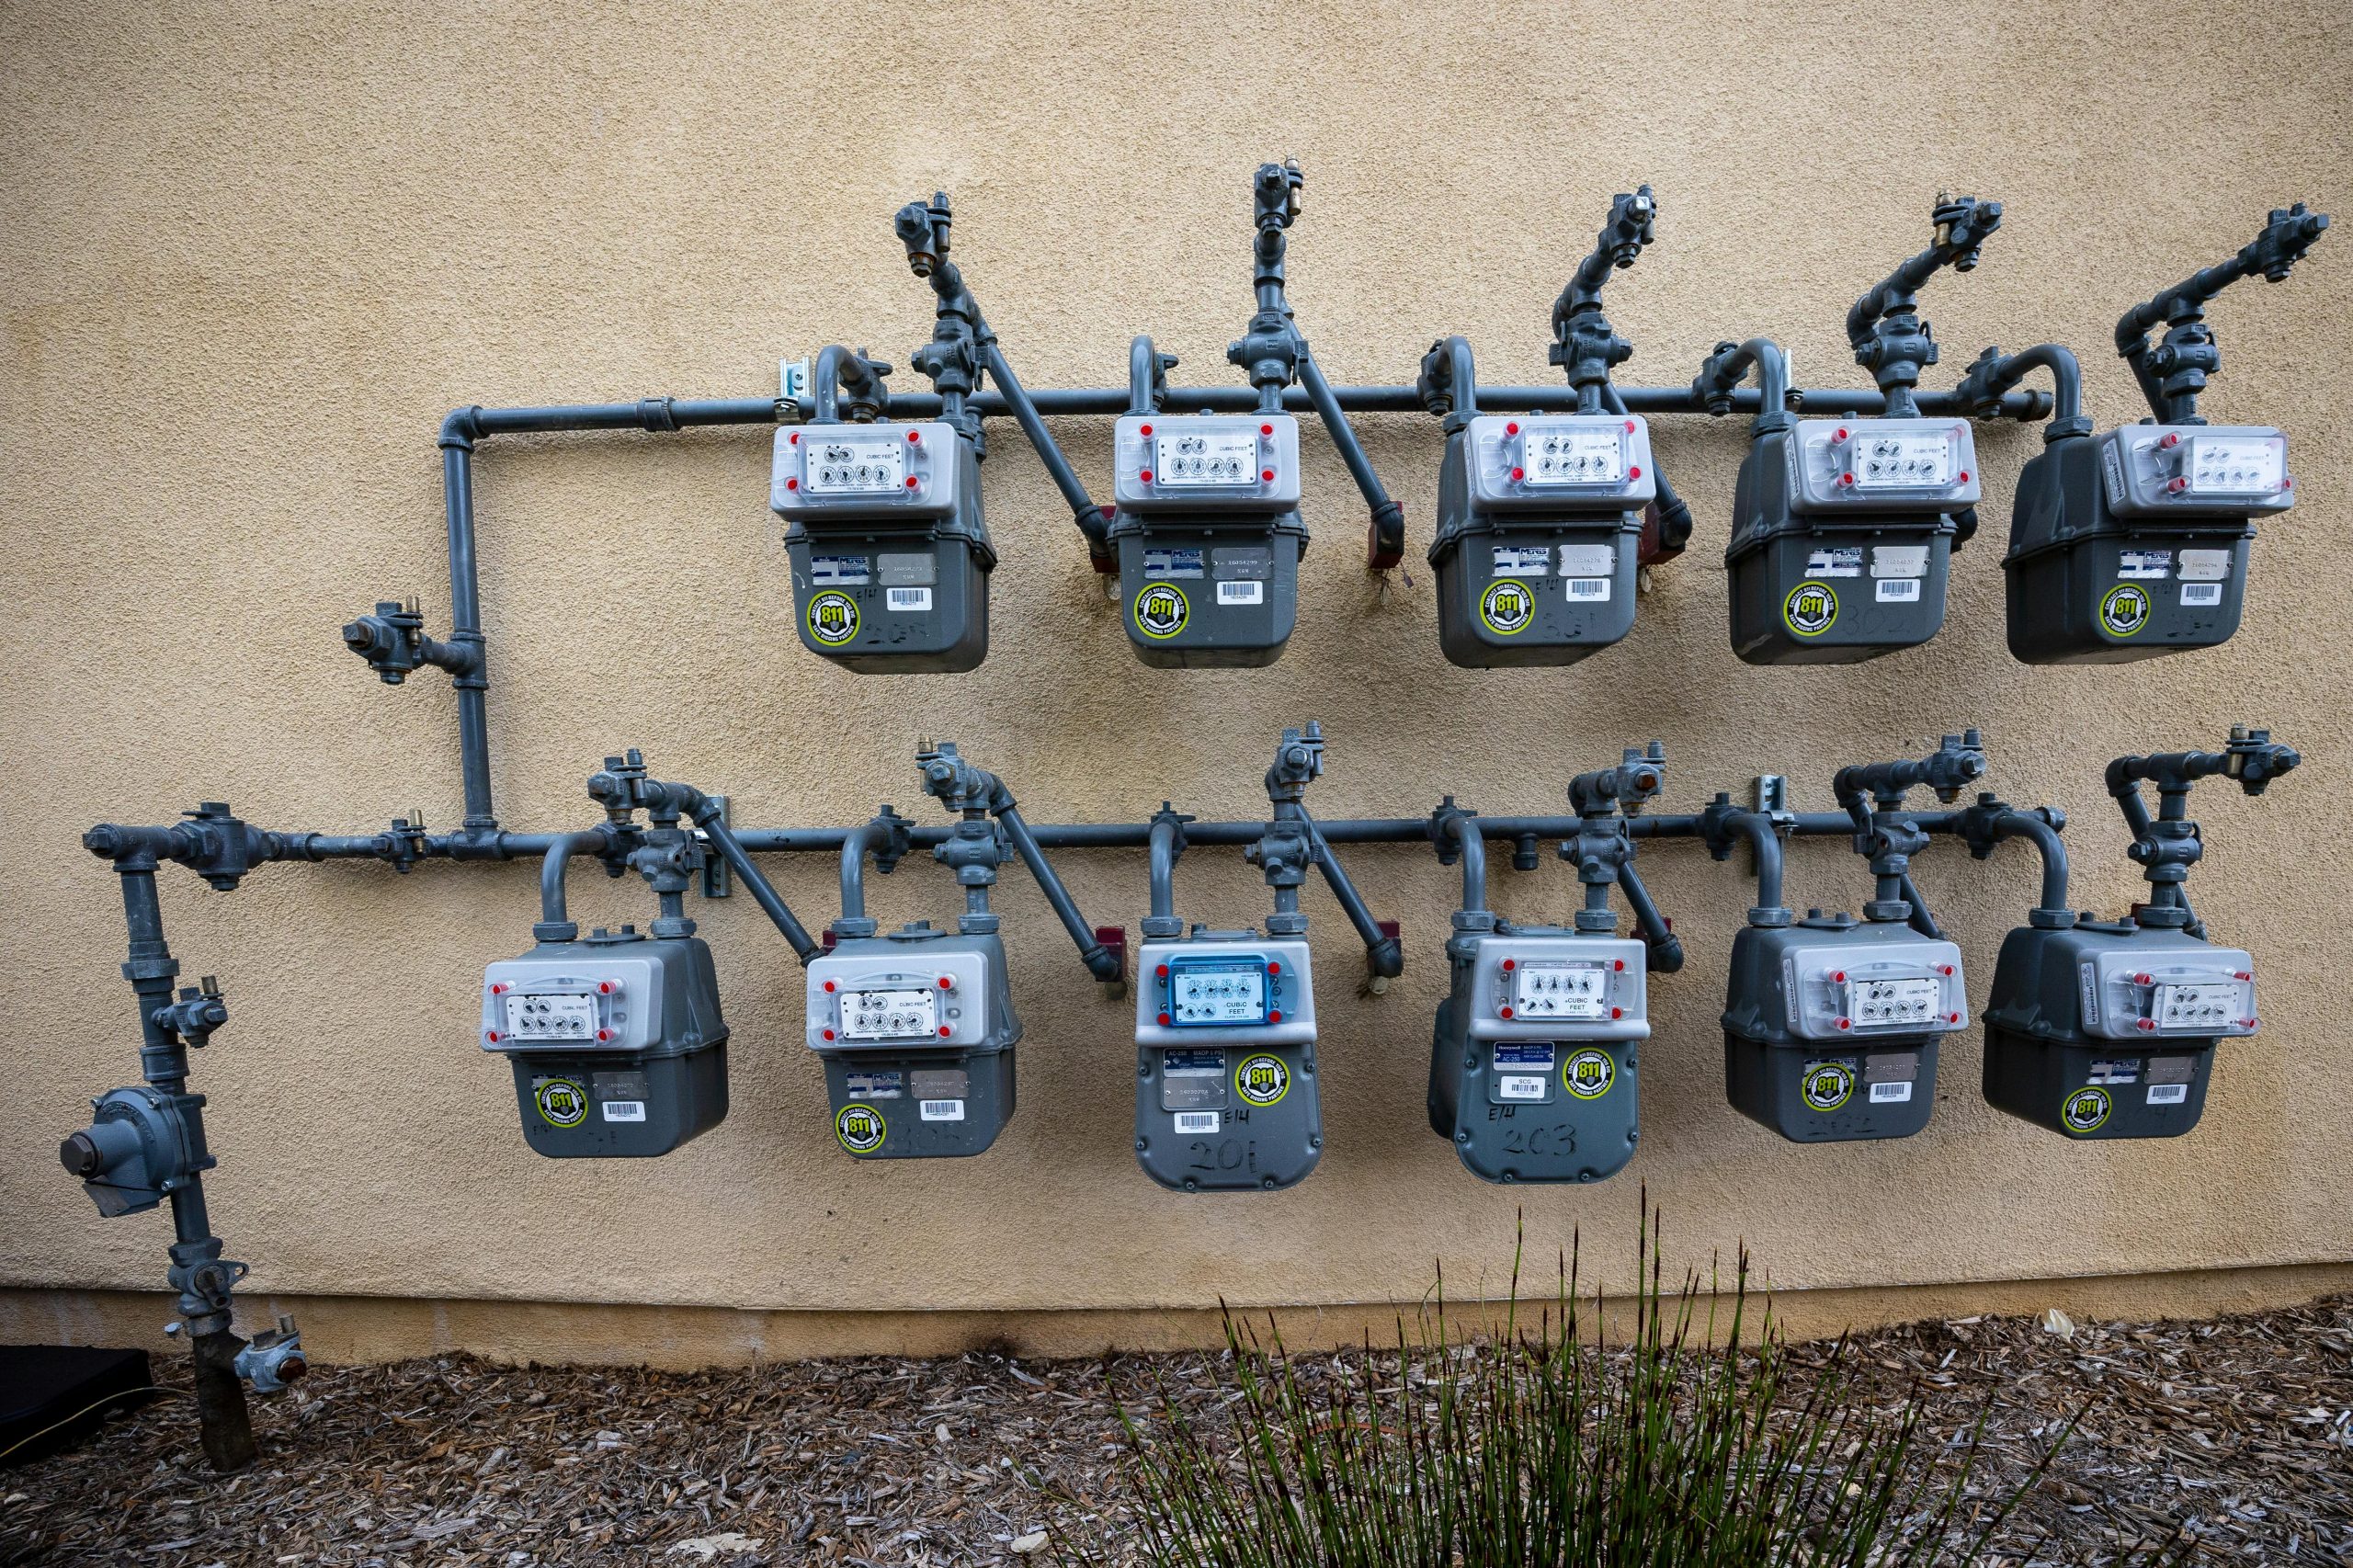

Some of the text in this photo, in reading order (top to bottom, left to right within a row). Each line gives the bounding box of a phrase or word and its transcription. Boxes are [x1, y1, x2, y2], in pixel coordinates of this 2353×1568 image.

[1139, 590, 1153, 608] CONTACT
[1161, 587, 1177, 597] BEFORE
[1485, 589, 1497, 607] CONTACT
[1497, 595, 1518, 611] 811
[1790, 590, 1803, 607] CONTACT
[1811, 586, 1827, 595] BEFORE
[2105, 592, 2118, 609] CONTACT
[811, 600, 822, 618] CONTACT
[1150, 598, 1173, 616] 811
[1800, 597, 1822, 613] 811
[2115, 599, 2136, 614] 811
[822, 607, 843, 622] 811
[1486, 614, 1495, 625] SAFE
[1513, 614, 1529, 629] PARTNER
[1139, 615, 1182, 634] SAFE DIGGING PARTNER
[1796, 623, 1813, 631] DIGGING
[1814, 617, 1831, 631] PARTNER
[2128, 617, 2144, 631] PARTNER
[812, 625, 822, 636] SAFE
[839, 625, 854, 640] PARTNER
[1240, 1062, 1252, 1080] CONTACT
[1568, 1056, 1579, 1074] CONTACT
[1579, 1063, 1599, 1077] 811
[1251, 1069, 1273, 1084] 811
[1817, 1077, 1838, 1091] 811
[1242, 1086, 1251, 1097] SAFE
[1268, 1086, 1284, 1100] PARTNER
[1569, 1080, 1577, 1090] SAFE
[1593, 1080, 1609, 1094] PARTNER
[550, 1093, 572, 1107] 811
[2077, 1100, 2097, 1113] 811
[849, 1118, 870, 1132] 811
[1190, 1138, 1258, 1174] 201
